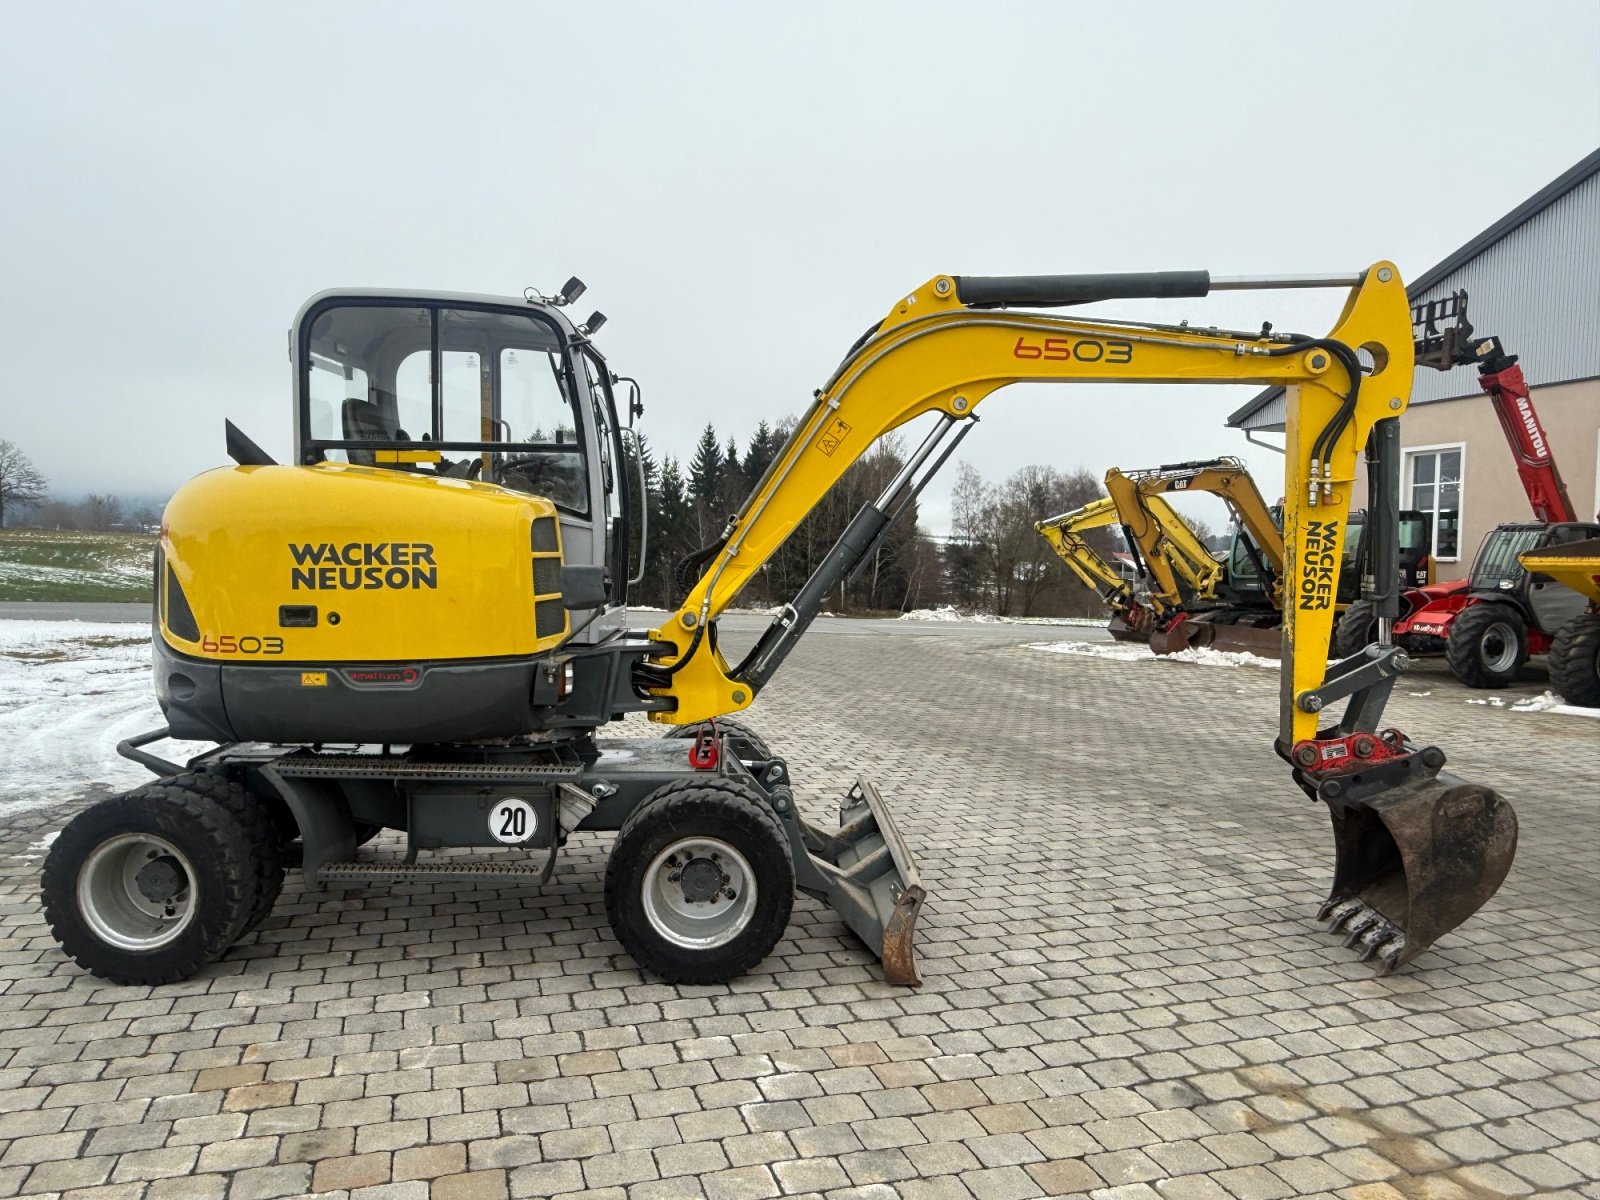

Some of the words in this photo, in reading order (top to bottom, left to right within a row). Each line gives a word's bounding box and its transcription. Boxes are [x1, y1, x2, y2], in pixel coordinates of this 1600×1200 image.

[1014, 337, 1133, 364] 6503
[1515, 397, 1548, 458] MANITOU
[1174, 480, 1188, 490] CAT
[288, 543, 437, 566] WACKER
[1299, 520, 1322, 611] NEUSON
[1315, 520, 1339, 611] WACKER
[291, 567, 438, 590] NEUSON
[202, 634, 284, 655] 6503
[500, 806, 526, 837] 20
